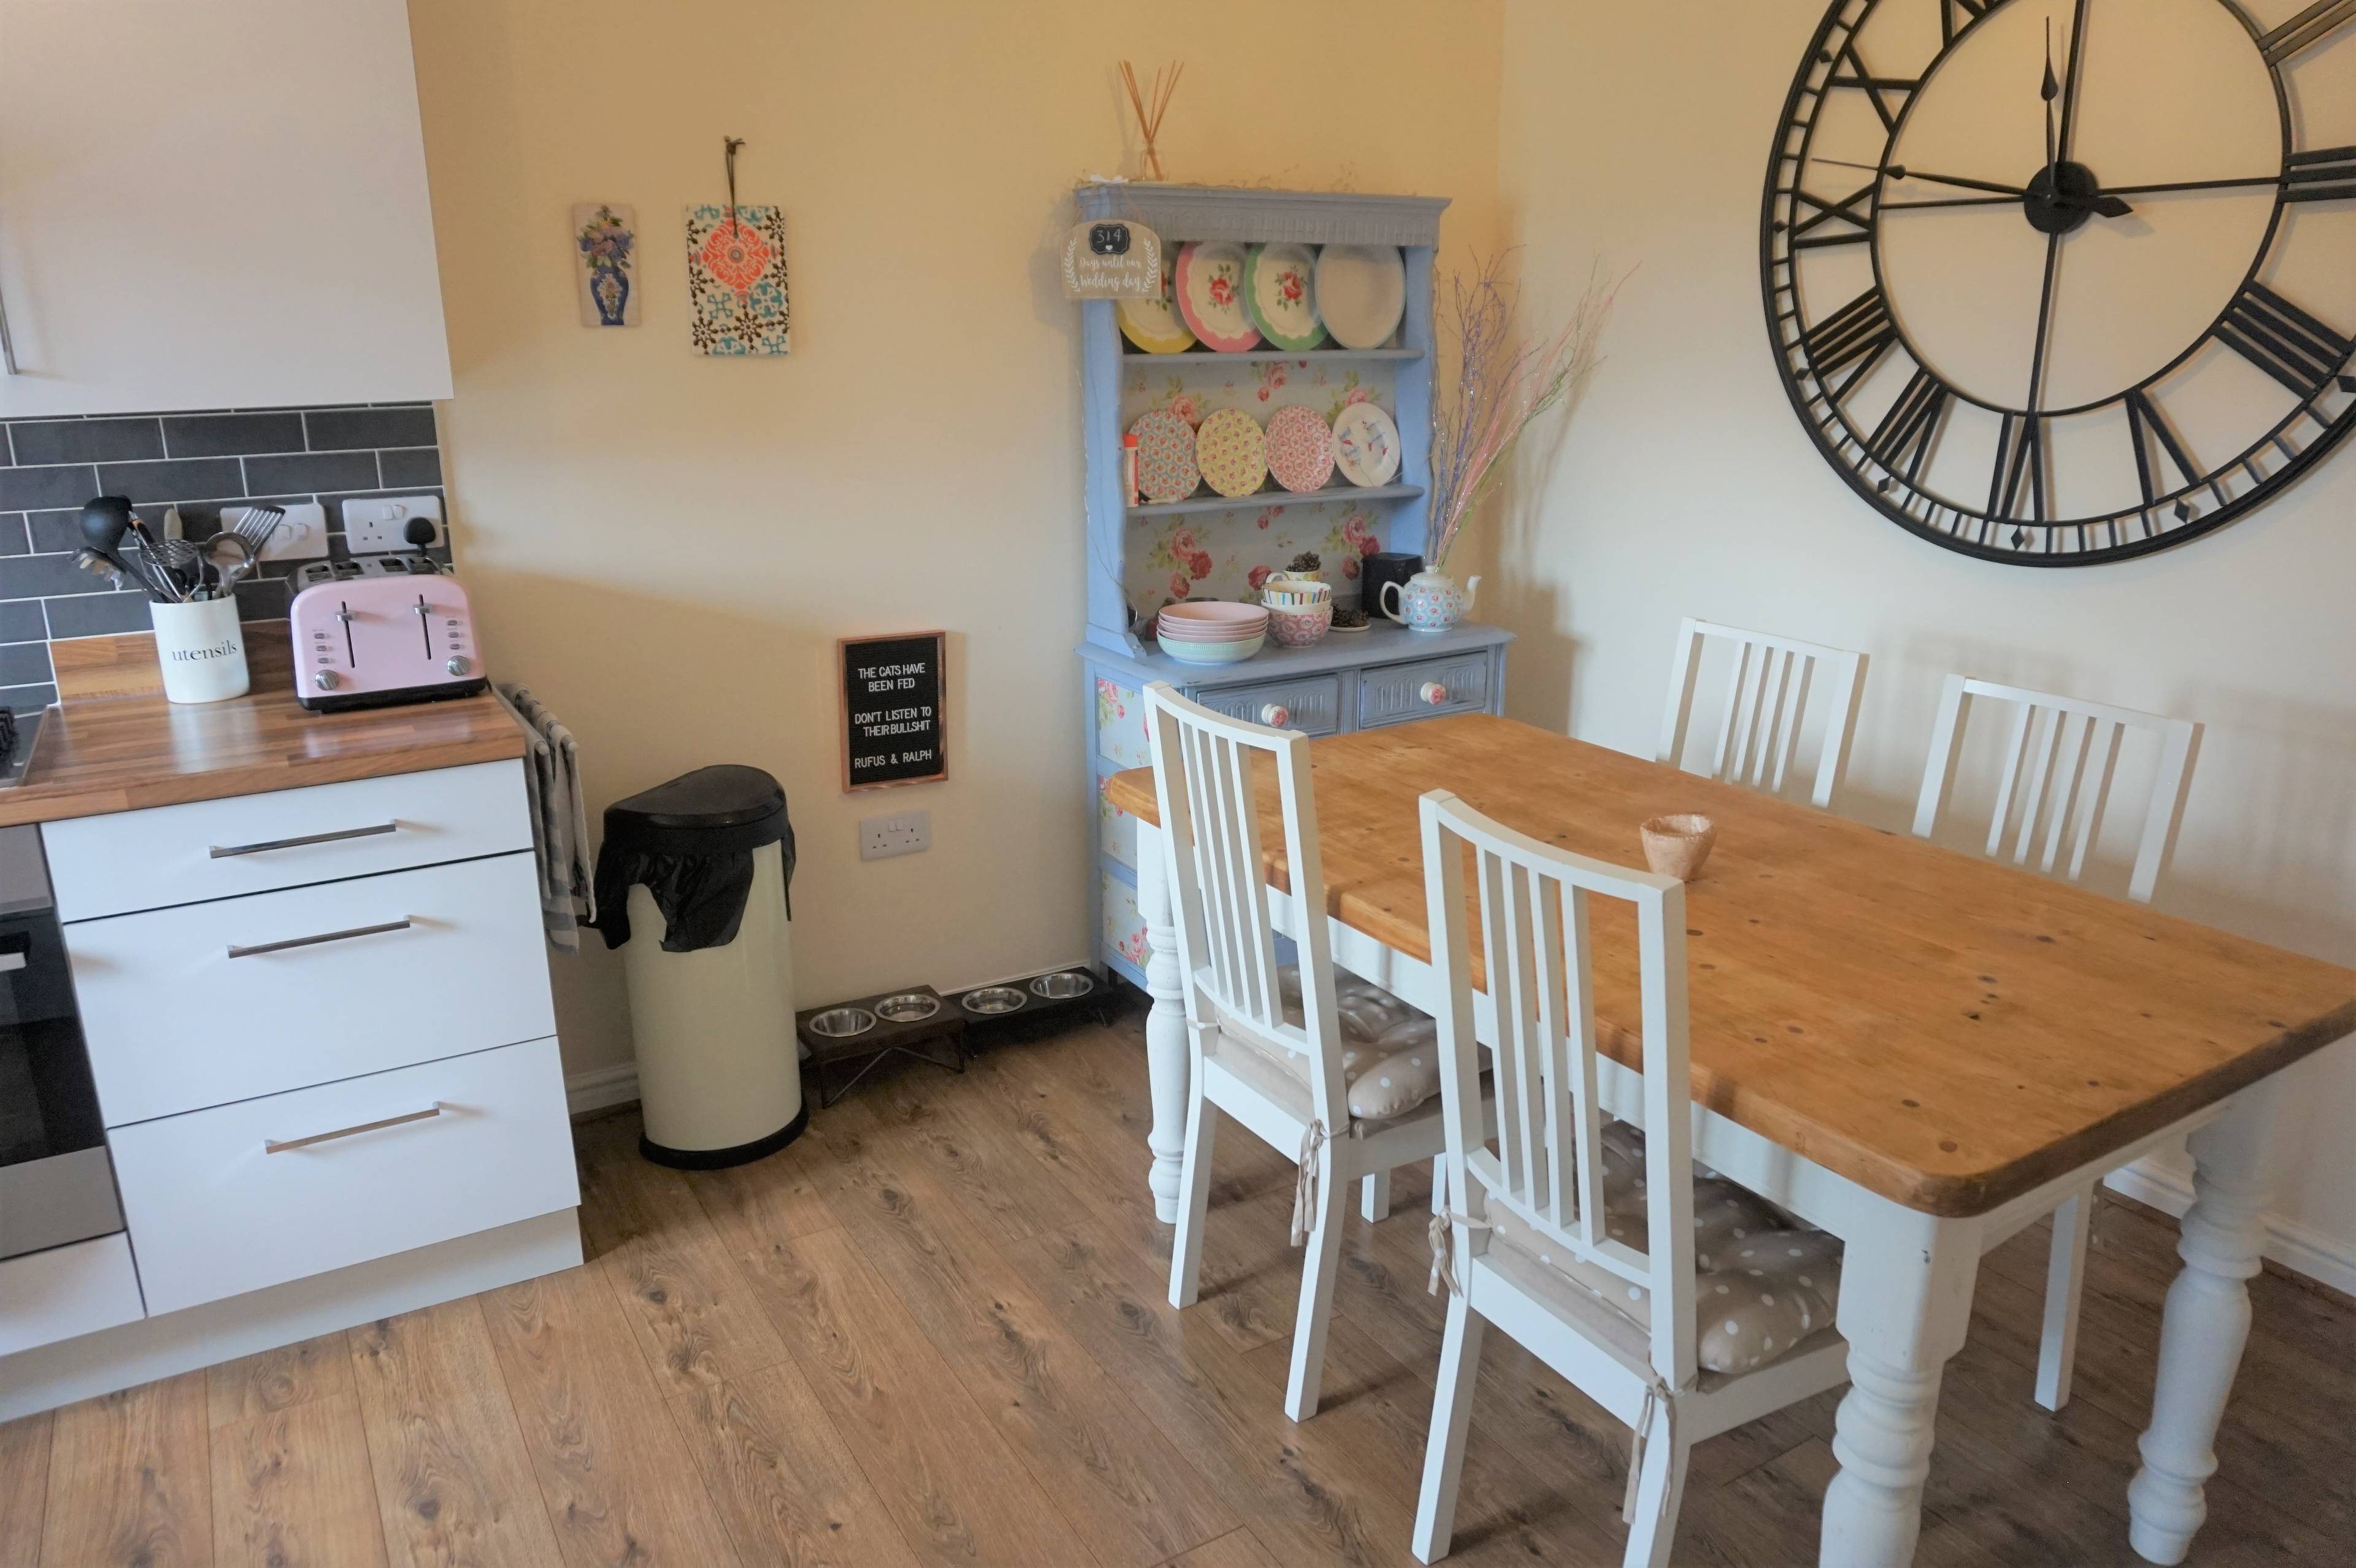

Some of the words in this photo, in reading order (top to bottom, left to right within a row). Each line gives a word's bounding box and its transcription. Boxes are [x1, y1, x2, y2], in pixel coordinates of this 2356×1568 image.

[1830, 40, 1920, 134] X
[1096, 228, 1122, 244] 314
[1079, 256, 1099, 271] Days
[1103, 255, 1124, 268] until
[1079, 272, 1120, 291] Wedding
[1122, 272, 1141, 291] day
[2124, 388, 2205, 505] V
[172, 640, 237, 661] utensils
[858, 667, 877, 679] THE
[879, 665, 901, 677] CATS
[902, 663, 926, 675] HAVE
[868, 679, 893, 692] BEEN
[897, 677, 915, 690] FED
[855, 711, 882, 724] DON'T
[885, 707, 917, 721] LISTEN
[920, 706, 931, 717] TO
[863, 724, 890, 737] THEIR
[890, 720, 931, 734] BULLSHIT
[854, 755, 885, 769] RUFUS
[890, 753, 899, 764] &
[903, 749, 932, 763] RALPH
